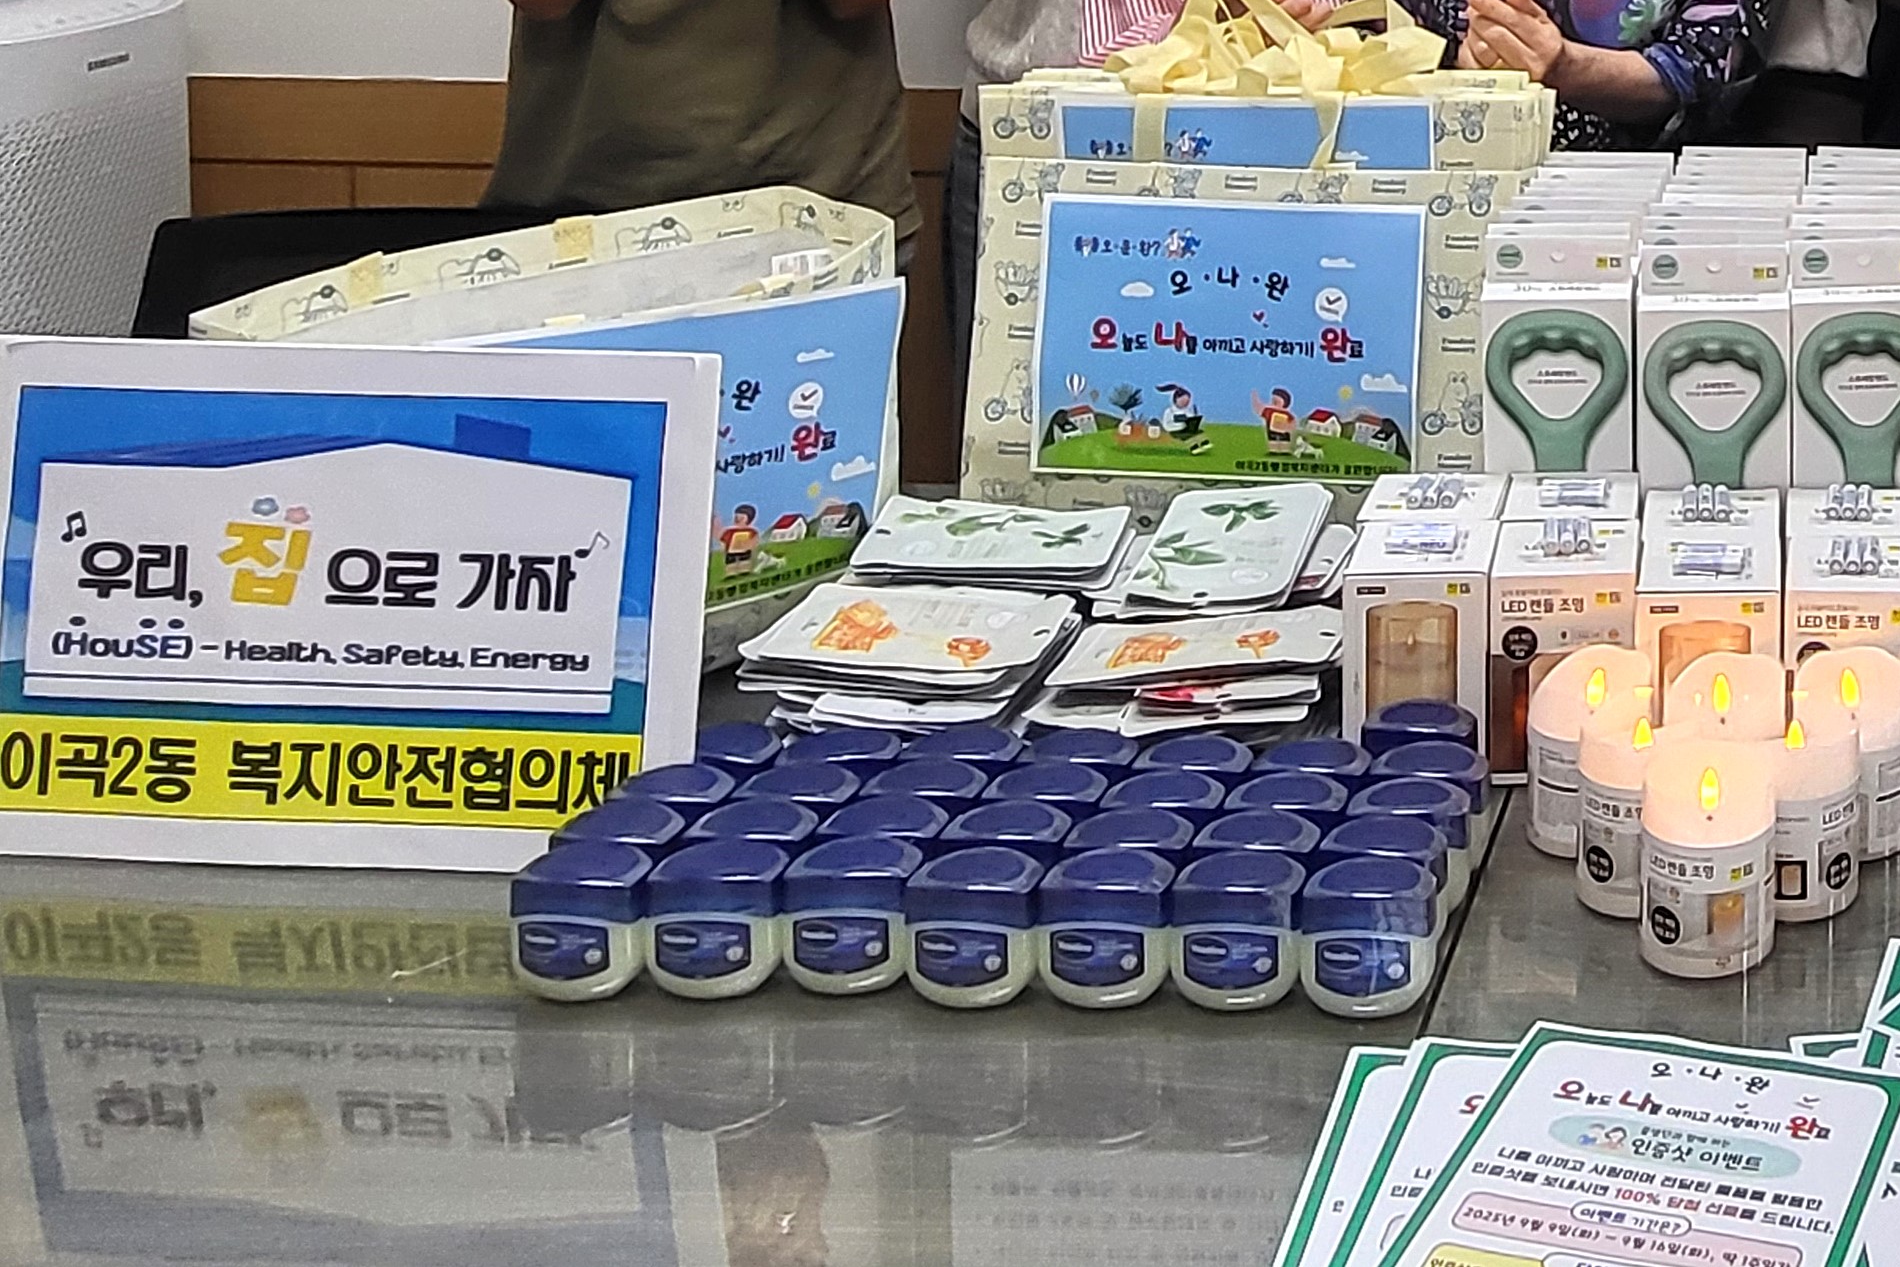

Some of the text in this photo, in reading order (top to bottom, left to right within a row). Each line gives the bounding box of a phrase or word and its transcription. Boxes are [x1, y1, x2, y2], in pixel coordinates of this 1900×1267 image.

[78, 541, 204, 609] 우리,
[456, 552, 576, 613] 가자
[0, 731, 630, 815] 이곡2동 복지안전협의체
[1614, 1187, 1661, 1206] 100%
